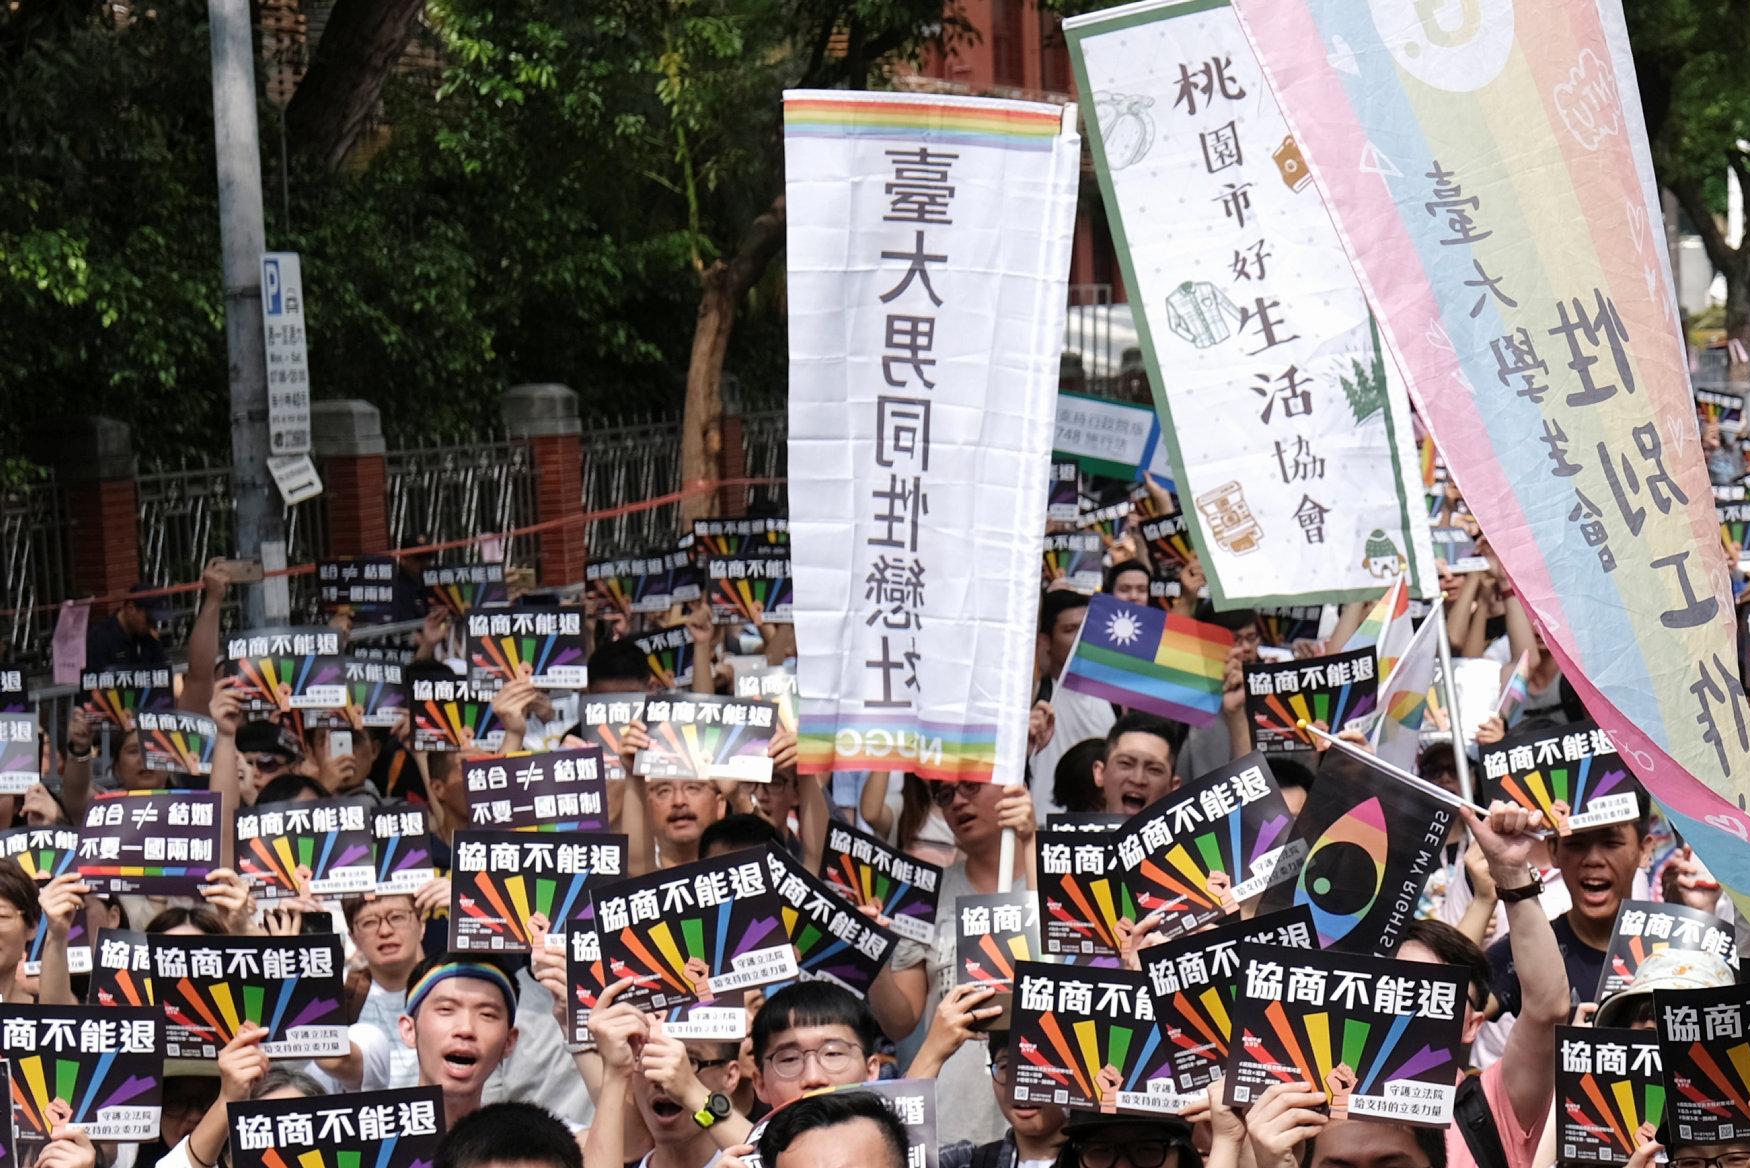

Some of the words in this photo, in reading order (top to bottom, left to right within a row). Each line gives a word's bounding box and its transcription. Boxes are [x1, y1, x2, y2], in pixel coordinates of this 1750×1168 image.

[1174, 56, 1331, 545] 桃園市好生活協會
[710, 559, 790, 579] 協商不能
[469, 614, 580, 636] 協商不能退
[228, 633, 339, 659] 協商不能退
[1248, 656, 1374, 696] 協商不能退
[647, 702, 772, 727] 協商不能退
[468, 767, 507, 791] 結合
[554, 757, 598, 782] 結婚
[87, 805, 123, 827] 結合
[168, 803, 213, 827] 結婚
[238, 806, 365, 840] 協商不能退
[472, 792, 601, 825] 不要一國兩制
[1118, 766, 1271, 871] 協商不能退
[80, 837, 212, 861] 不要一國兩制
[458, 843, 620, 876] 協商不能退
[831, 829, 936, 893] 協商不能退
[599, 861, 767, 933] 協商不能退
[155, 948, 334, 980] 協商不能退
[1246, 959, 1457, 1020] 協商不能退
[3, 1020, 155, 1053] 商不能退
[1354, 1096, 1442, 1117] 給支持的立委力量
[1389, 1083, 1443, 1099] 守護立法院
[237, 1100, 437, 1150] 協商不能退
